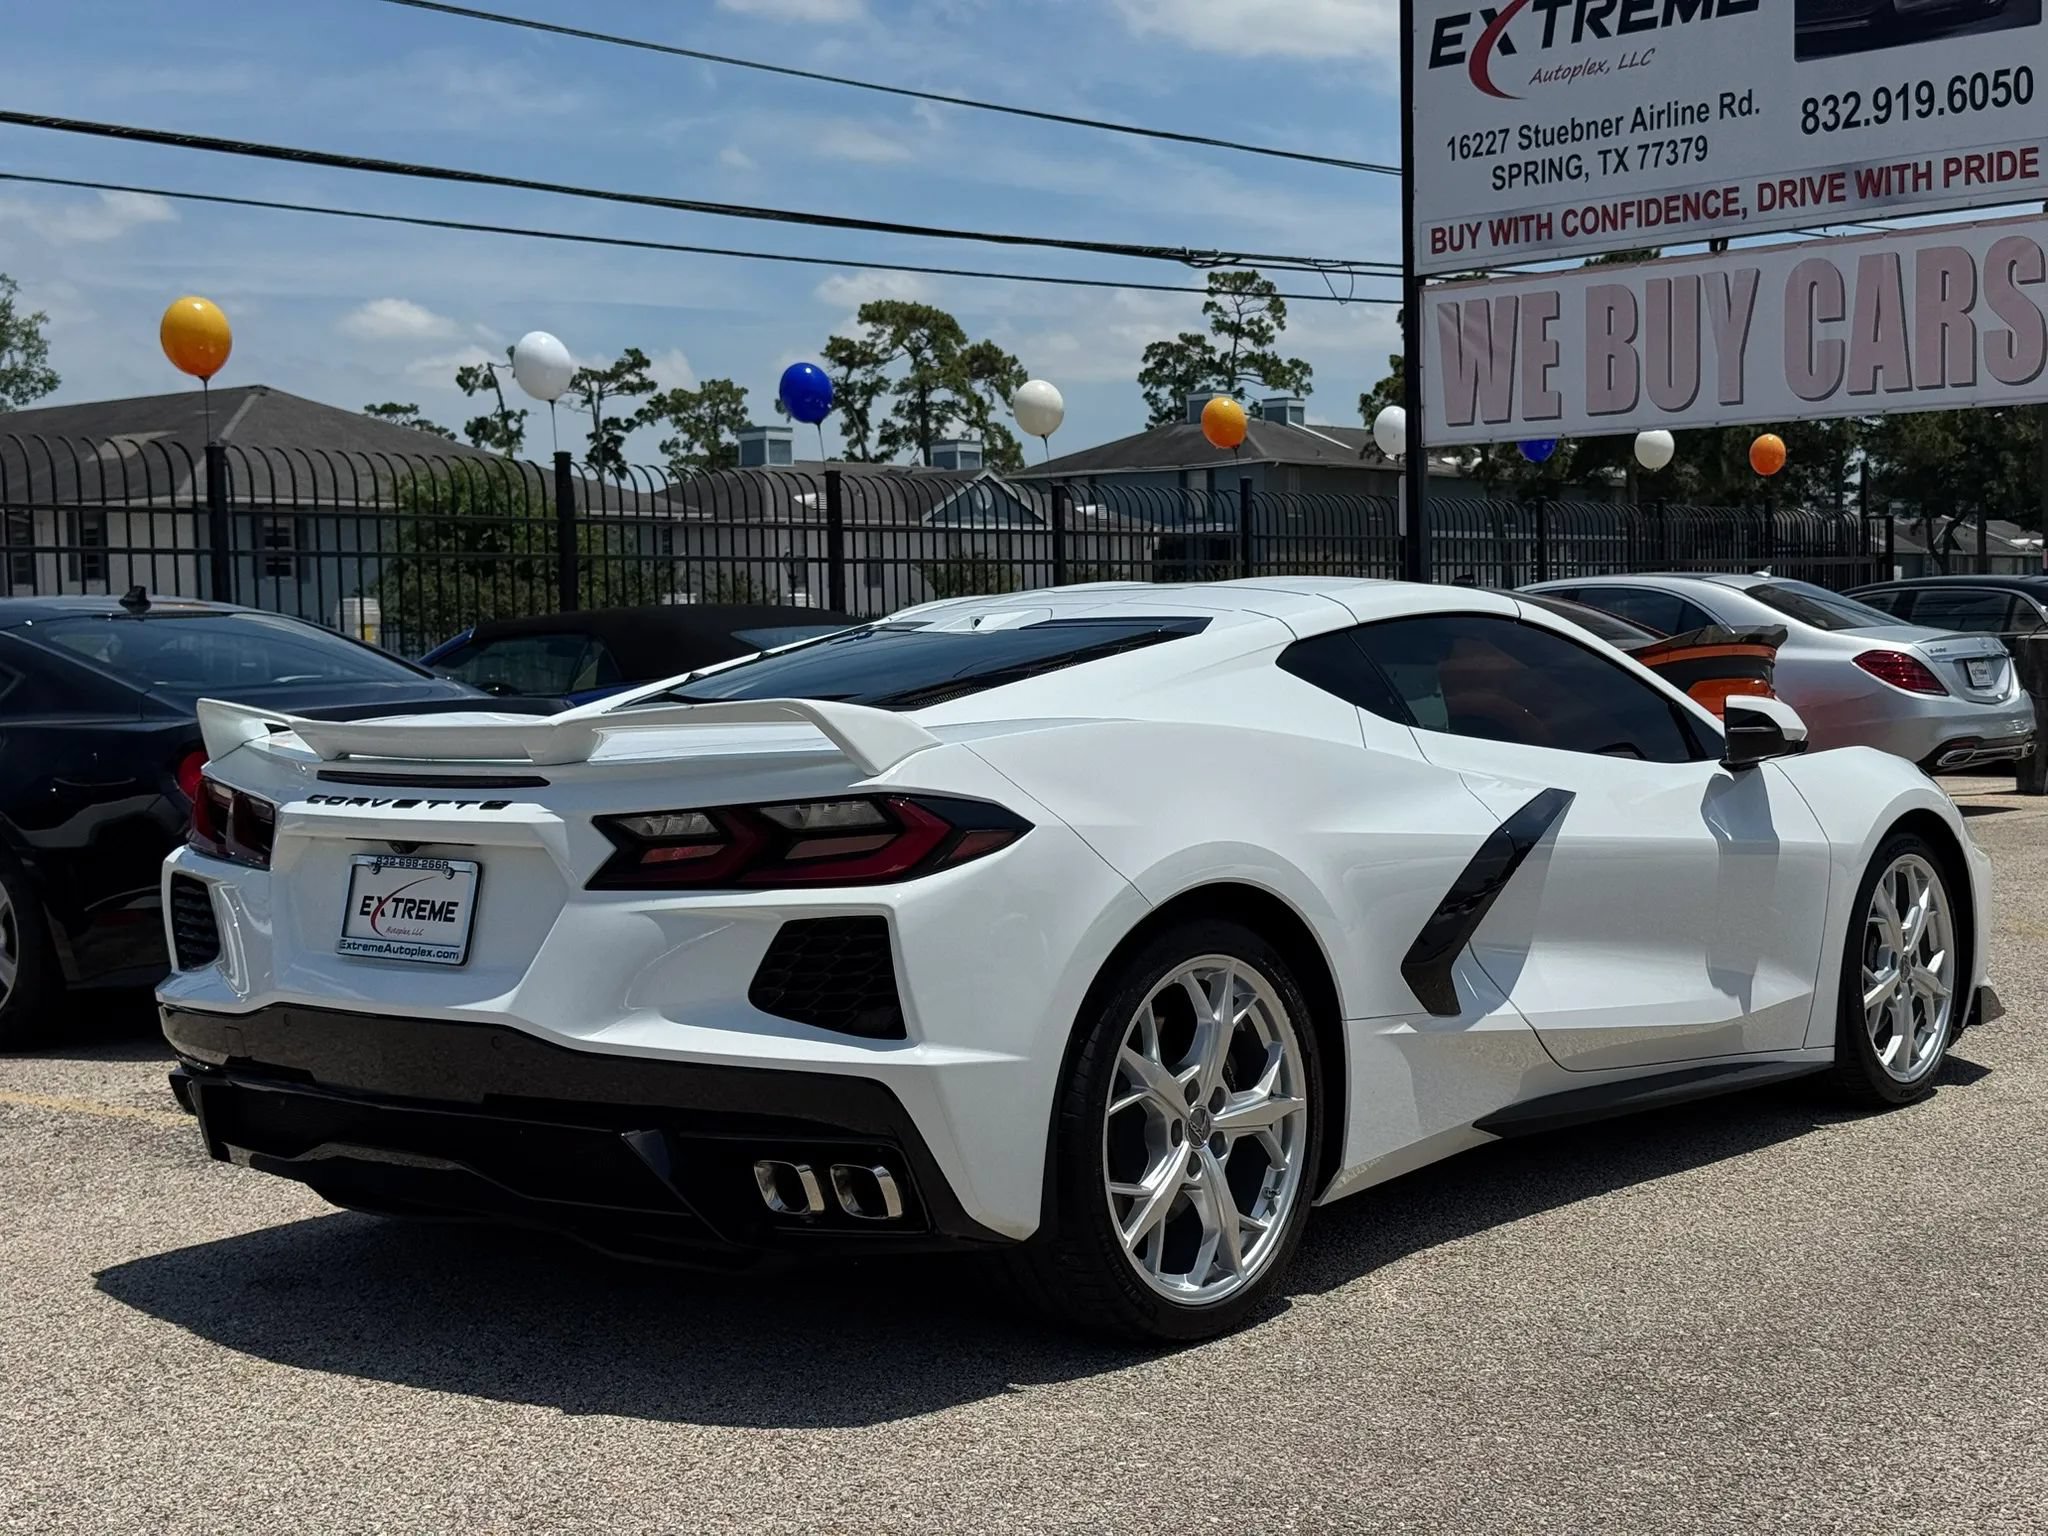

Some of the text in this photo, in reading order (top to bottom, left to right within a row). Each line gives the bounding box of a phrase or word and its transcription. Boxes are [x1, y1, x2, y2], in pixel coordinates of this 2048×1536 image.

[1528, 48, 1655, 85] Autoplex, LLC
[1447, 88, 1760, 161] 16227 Stuebner Airline Rd.
[1801, 65, 2034, 135] 832.919.6050
[1492, 135, 1709, 191] SPRING, TX 77379
[1430, 147, 2039, 255] BUY WITH CONFIDENCE, DRIVE WITH PRIDE
[1436, 235, 2047, 428] WE BUY CARS
[306, 794, 513, 811] CORVETTE
[360, 895, 459, 922] EXTREME
[340, 939, 459, 960] ExtremeAutoplex.com
